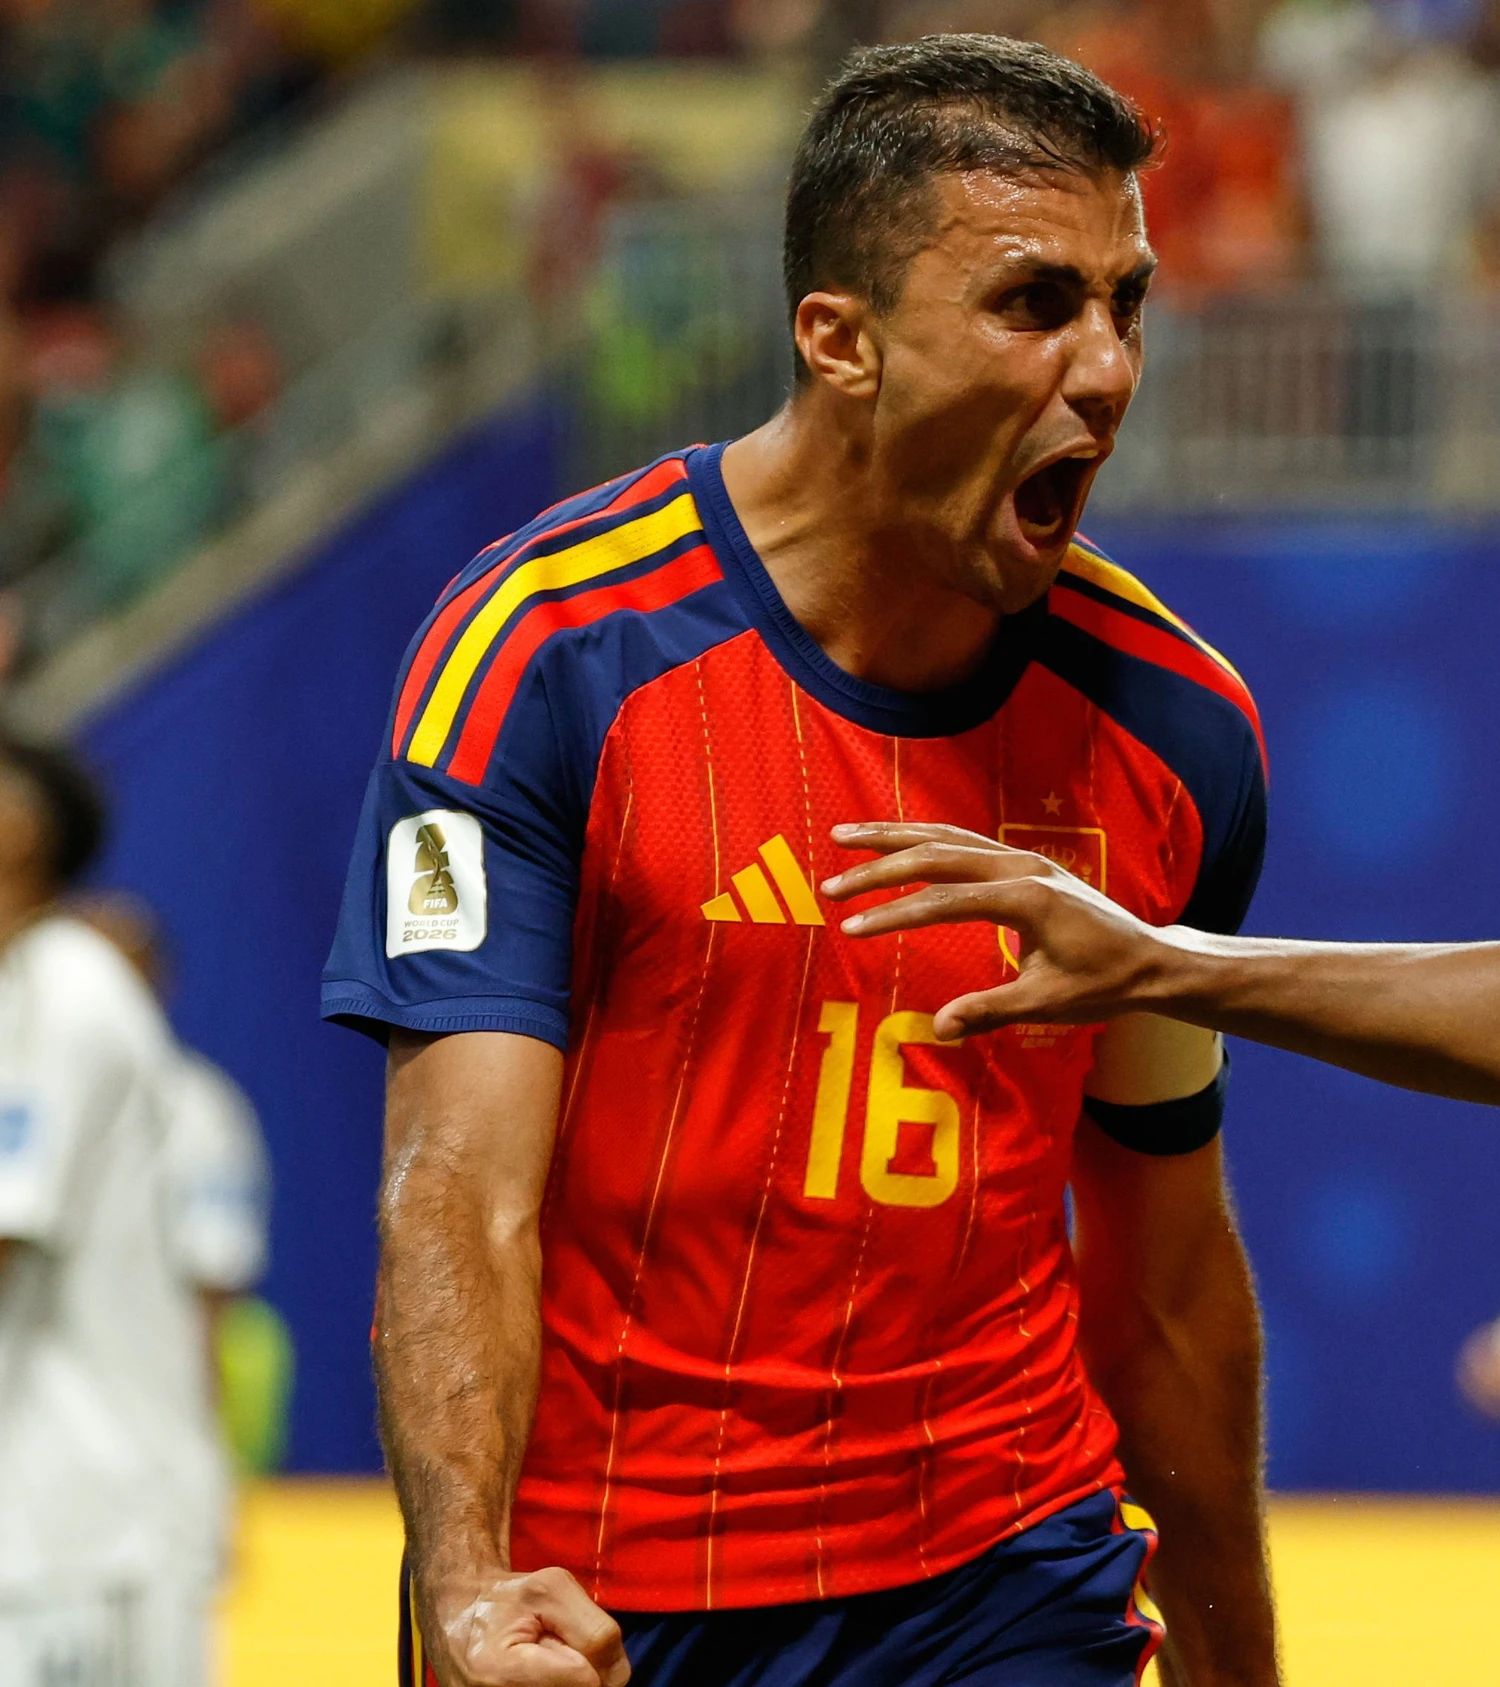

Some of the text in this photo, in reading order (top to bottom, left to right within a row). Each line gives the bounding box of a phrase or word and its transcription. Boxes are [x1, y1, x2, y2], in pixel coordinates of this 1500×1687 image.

[423, 897, 448, 910] FIFA
[404, 919, 459, 928] WORLD CUP
[402, 928, 458, 943] 2026
[803, 1000, 963, 1208] 16
